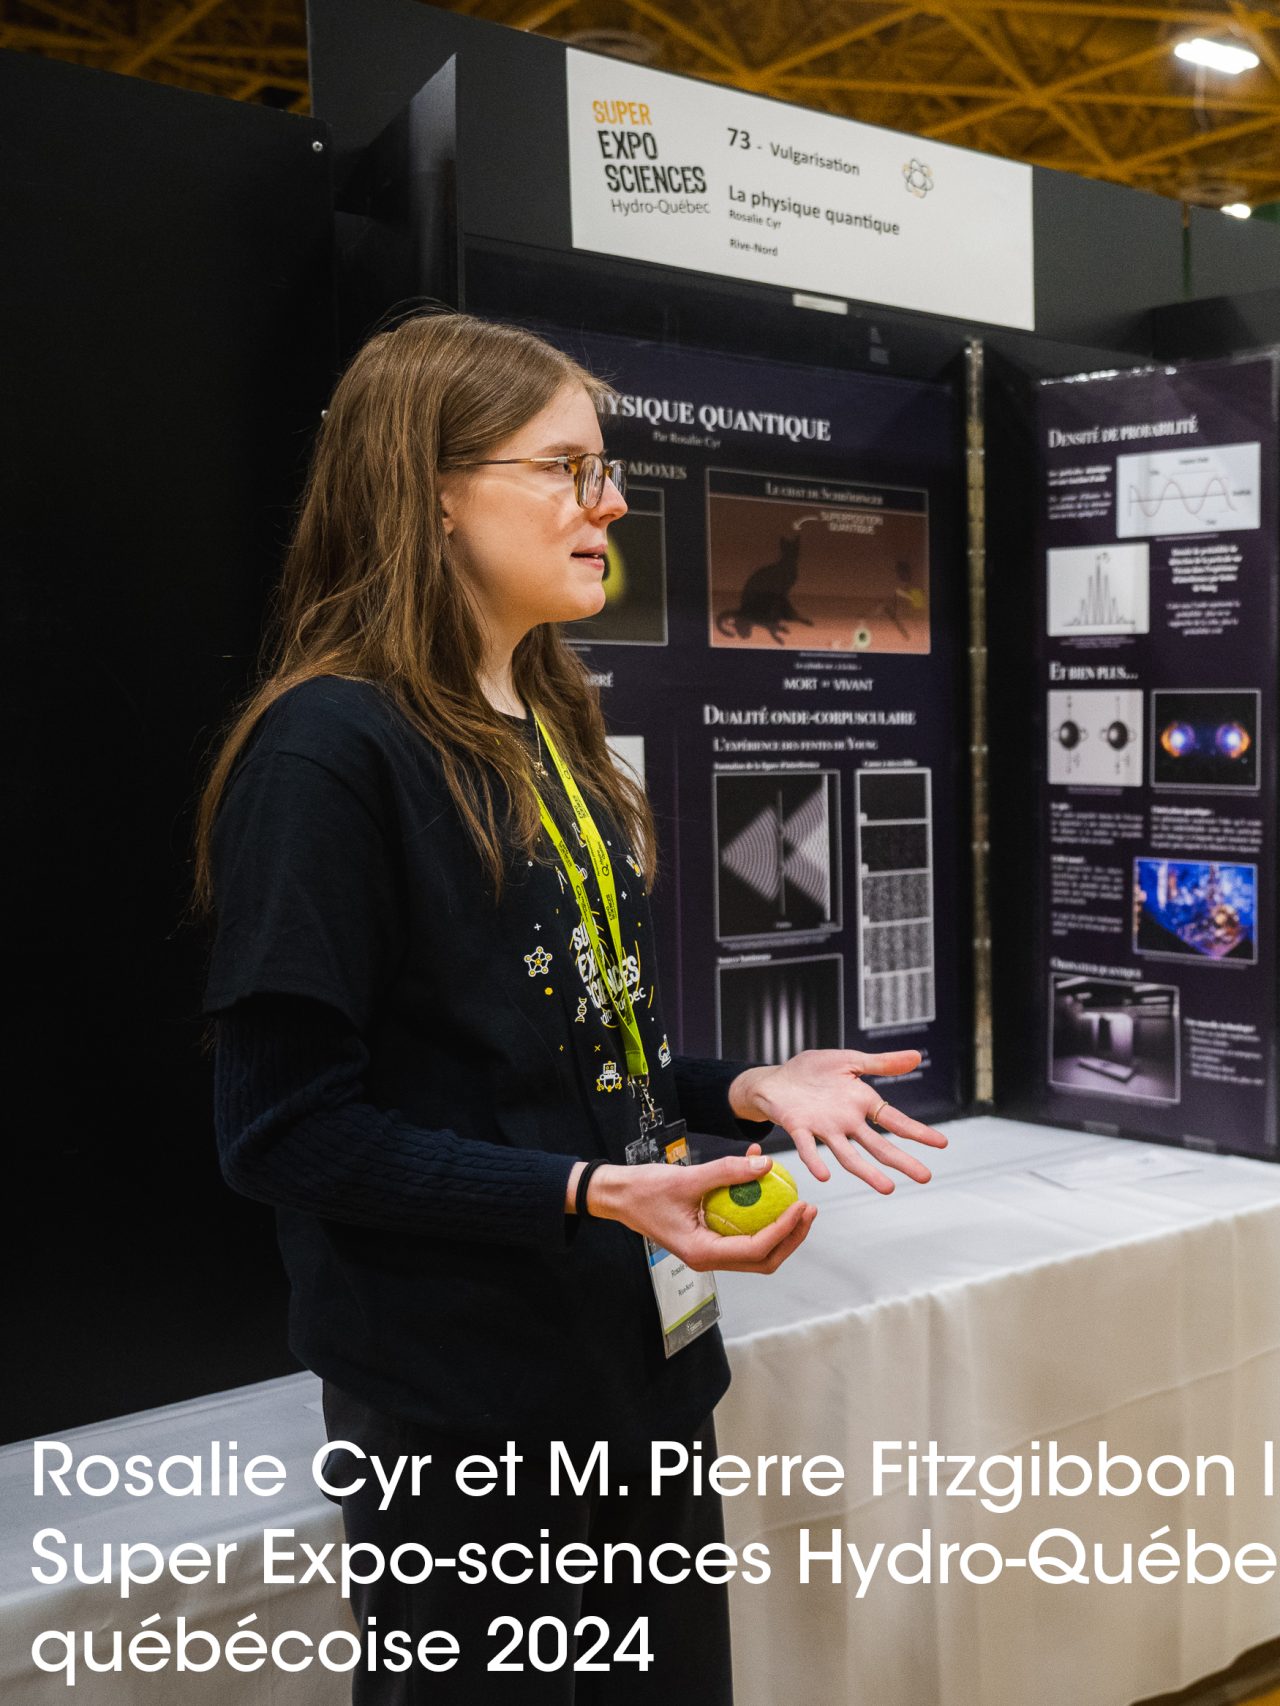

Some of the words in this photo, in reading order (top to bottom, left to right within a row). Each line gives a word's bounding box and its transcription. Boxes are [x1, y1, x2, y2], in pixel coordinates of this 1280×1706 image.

[592, 99, 653, 126] SUPER
[597, 129, 659, 160] EXPO
[727, 127, 751, 150] 73
[769, 141, 860, 176] Vulgarisation
[604, 164, 707, 194] SCIENCES
[610, 199, 711, 217] Hydro-Québec
[728, 185, 747, 202] La
[751, 190, 821, 219] physique
[825, 207, 900, 235] quantique
[729, 209, 764, 226] Rosalie
[766, 217, 782, 230] Cyr
[729, 238, 779, 257] Rive-Nord
[699, 403, 832, 442] QUANTIQUE
[783, 677, 817, 691] MORT
[833, 677, 874, 692] VIVANT
[703, 704, 769, 726] DUALITÉ
